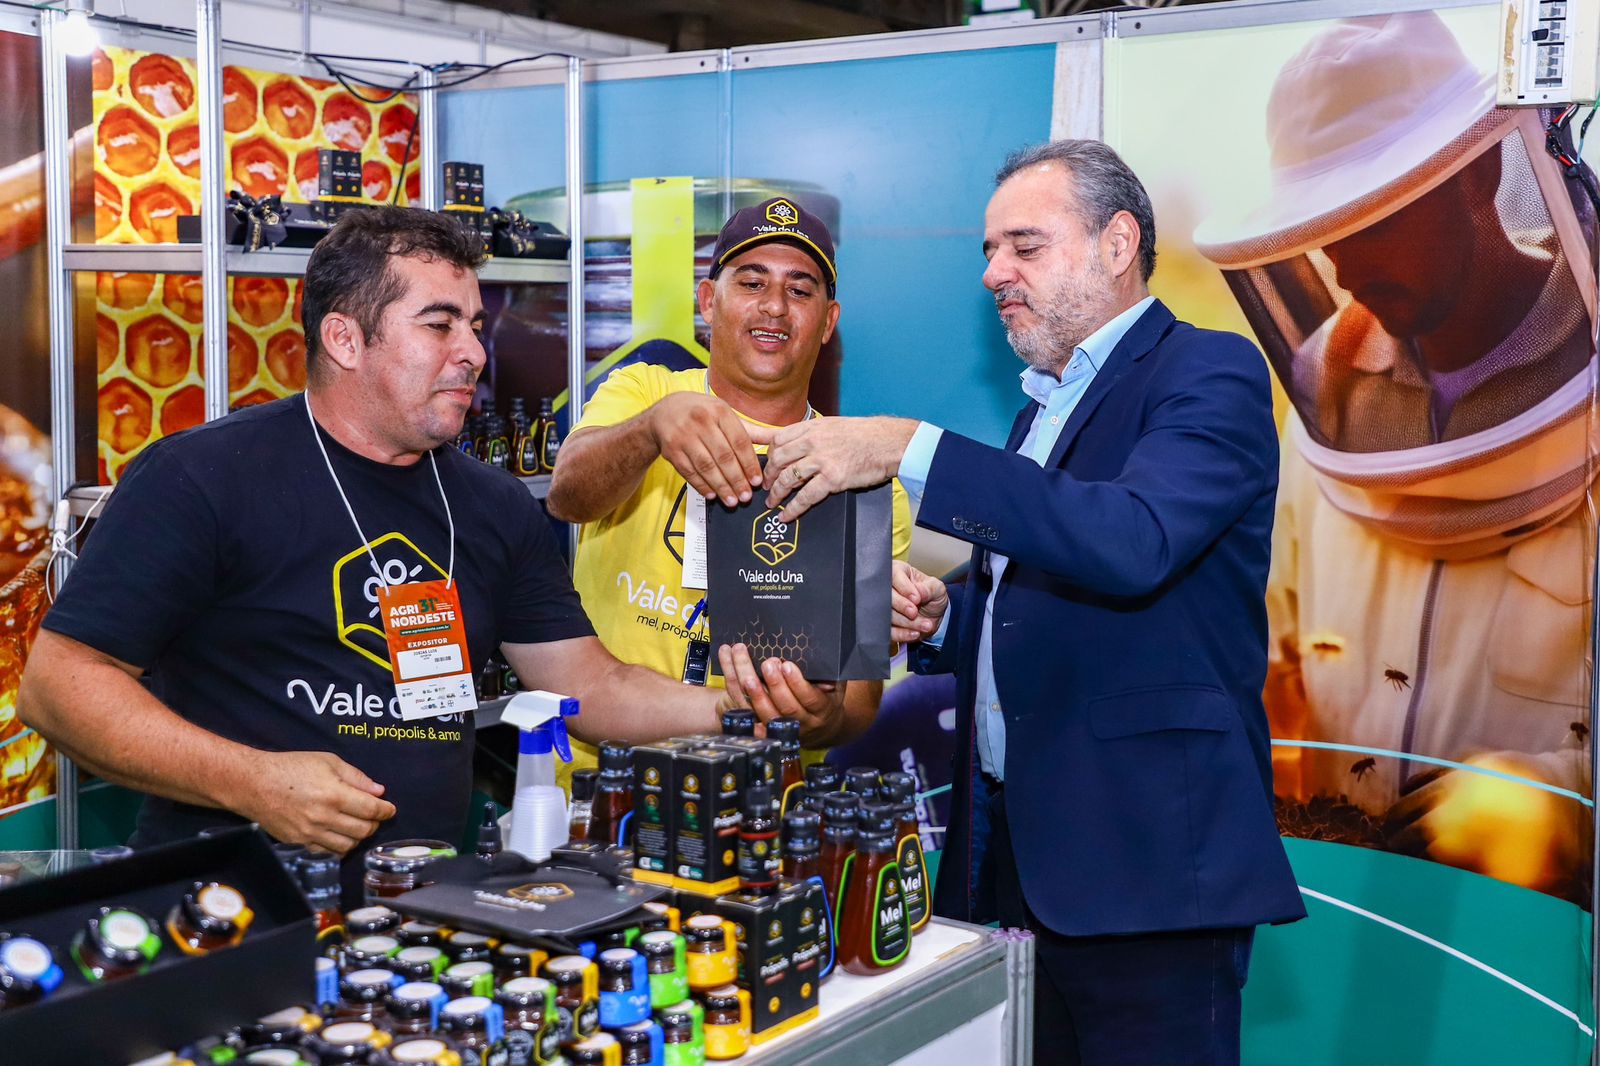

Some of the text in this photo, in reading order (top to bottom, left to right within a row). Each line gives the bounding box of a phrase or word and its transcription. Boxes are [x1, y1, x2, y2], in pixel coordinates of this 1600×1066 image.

[752, 224, 777, 232] Vale
[738, 568, 804, 583] Vale do Una
[616, 571, 678, 616] Vale
[389, 604, 419, 617] AGRI
[391, 611, 456, 628] NORDESTE
[636, 615, 710, 643] mel, própolis
[407, 637, 448, 648] EXPOSITOR
[287, 678, 384, 717] Vale
[338, 722, 461, 741] mel, própolis & amo
[901, 872, 922, 893] Mel
[880, 901, 903, 927] Mel
